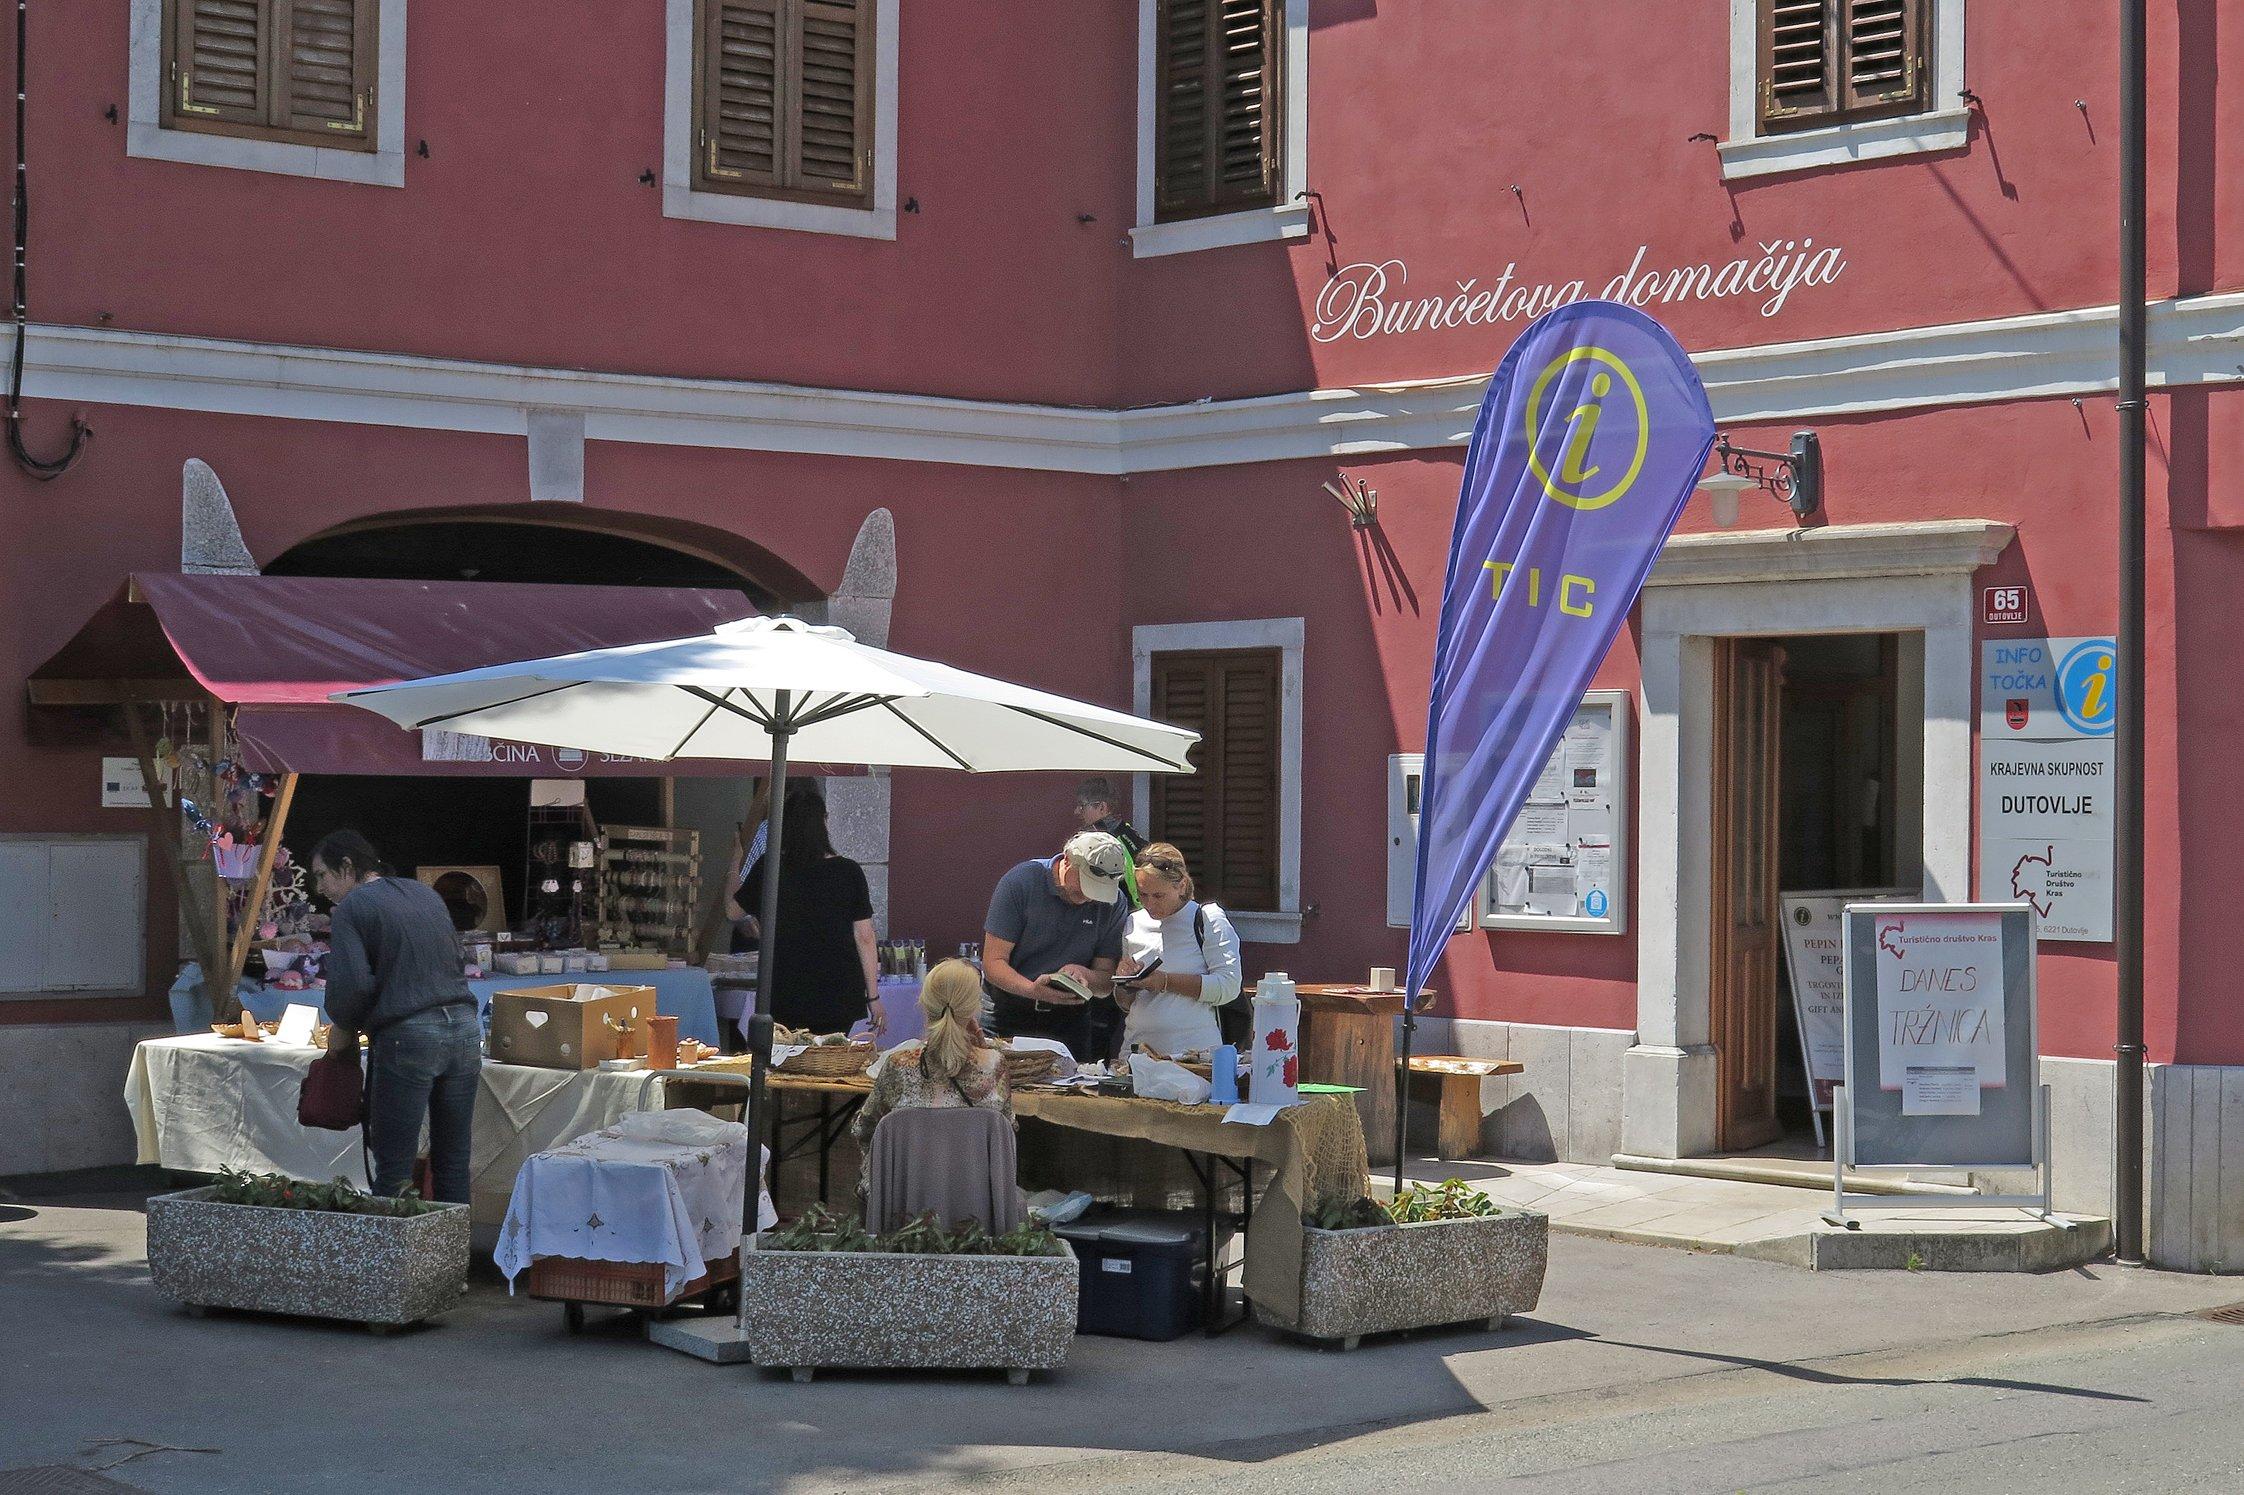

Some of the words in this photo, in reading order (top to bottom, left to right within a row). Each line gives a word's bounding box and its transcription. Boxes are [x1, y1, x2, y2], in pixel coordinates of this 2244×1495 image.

[1311, 259, 1590, 343] Bunčetova
[1599, 237, 1847, 318] domačija
[1482, 559, 1596, 619] TIC
[1994, 589, 2020, 610] 65
[1988, 611, 2022, 620] DUTOVLJE
[1995, 646, 2042, 664] INFO
[1989, 670, 2047, 690] TOČKA
[1990, 762, 2045, 776] KRAJEVNA
[2047, 762, 2104, 776] SKUPNOST
[2001, 795, 2092, 814] DUTOVLJE
[2046, 870, 2082, 878] Turistično
[1804, 938, 1836, 949] PEPIN
[1898, 935, 1941, 944] Turistično
[1943, 934, 1975, 943] društvo
[1977, 934, 1998, 942] Kras
[1900, 966, 1977, 992] DANES
[1808, 1005, 1828, 1014] GIFT
[1889, 1003, 1991, 1046] TRŽNICA
